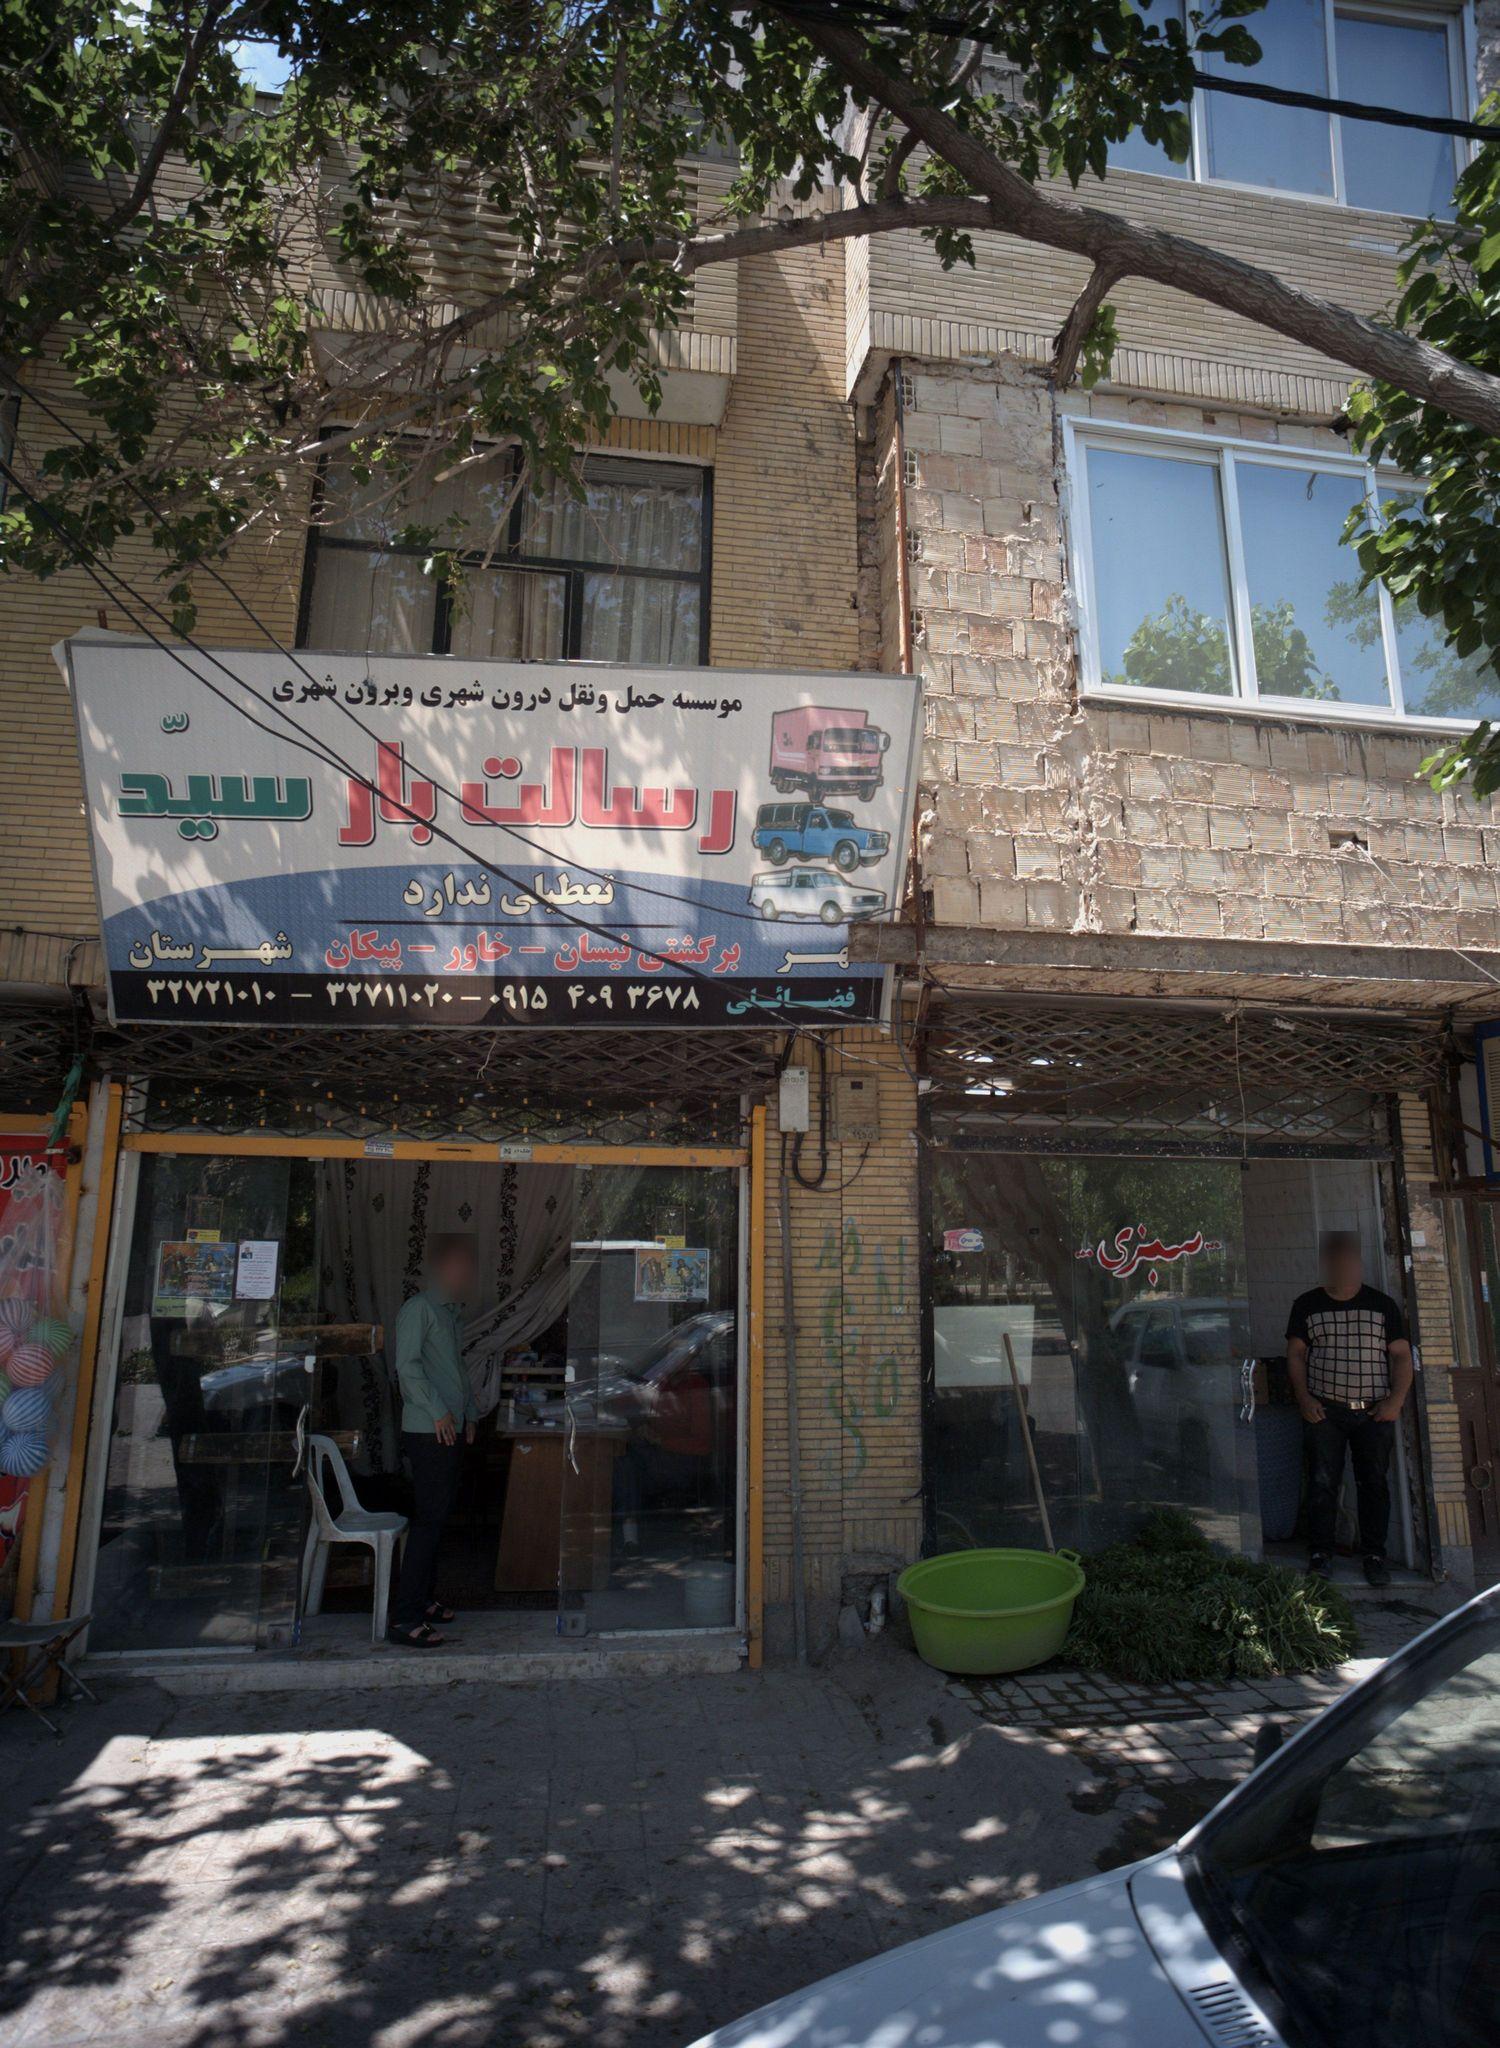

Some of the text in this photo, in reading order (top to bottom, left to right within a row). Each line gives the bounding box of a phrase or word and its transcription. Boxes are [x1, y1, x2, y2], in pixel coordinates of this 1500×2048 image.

[272, 674, 337, 703] شهری
[421, 680, 484, 709] شهری
[491, 686, 552, 712] درون
[615, 684, 665, 713] حمل
[672, 691, 743, 719] موسسه
[338, 741, 437, 846] بار
[460, 744, 738, 854] رسالت
[403, 872, 616, 916] تعطیلی ندارد
[128, 930, 293, 970] شهرستان
[324, 929, 404, 971] پیکان
[443, 931, 512, 971] خاور
[553, 933, 632, 972] نیسان
[636, 934, 741, 974] برگشتی
[776, 946, 849, 974] هر
[146, 979, 276, 1006] ۳۲۷۲۱۰۱۰
[326, 982, 453, 1008] ۳۲۷۱۱۰۲۰
[489, 984, 548, 1009] ۰۹۱۵
[567, 984, 613, 1009] ۴۰۹
[627, 985, 700, 1009] ۳۶۷۸
[1097, 1222, 1203, 1287] سبزی
